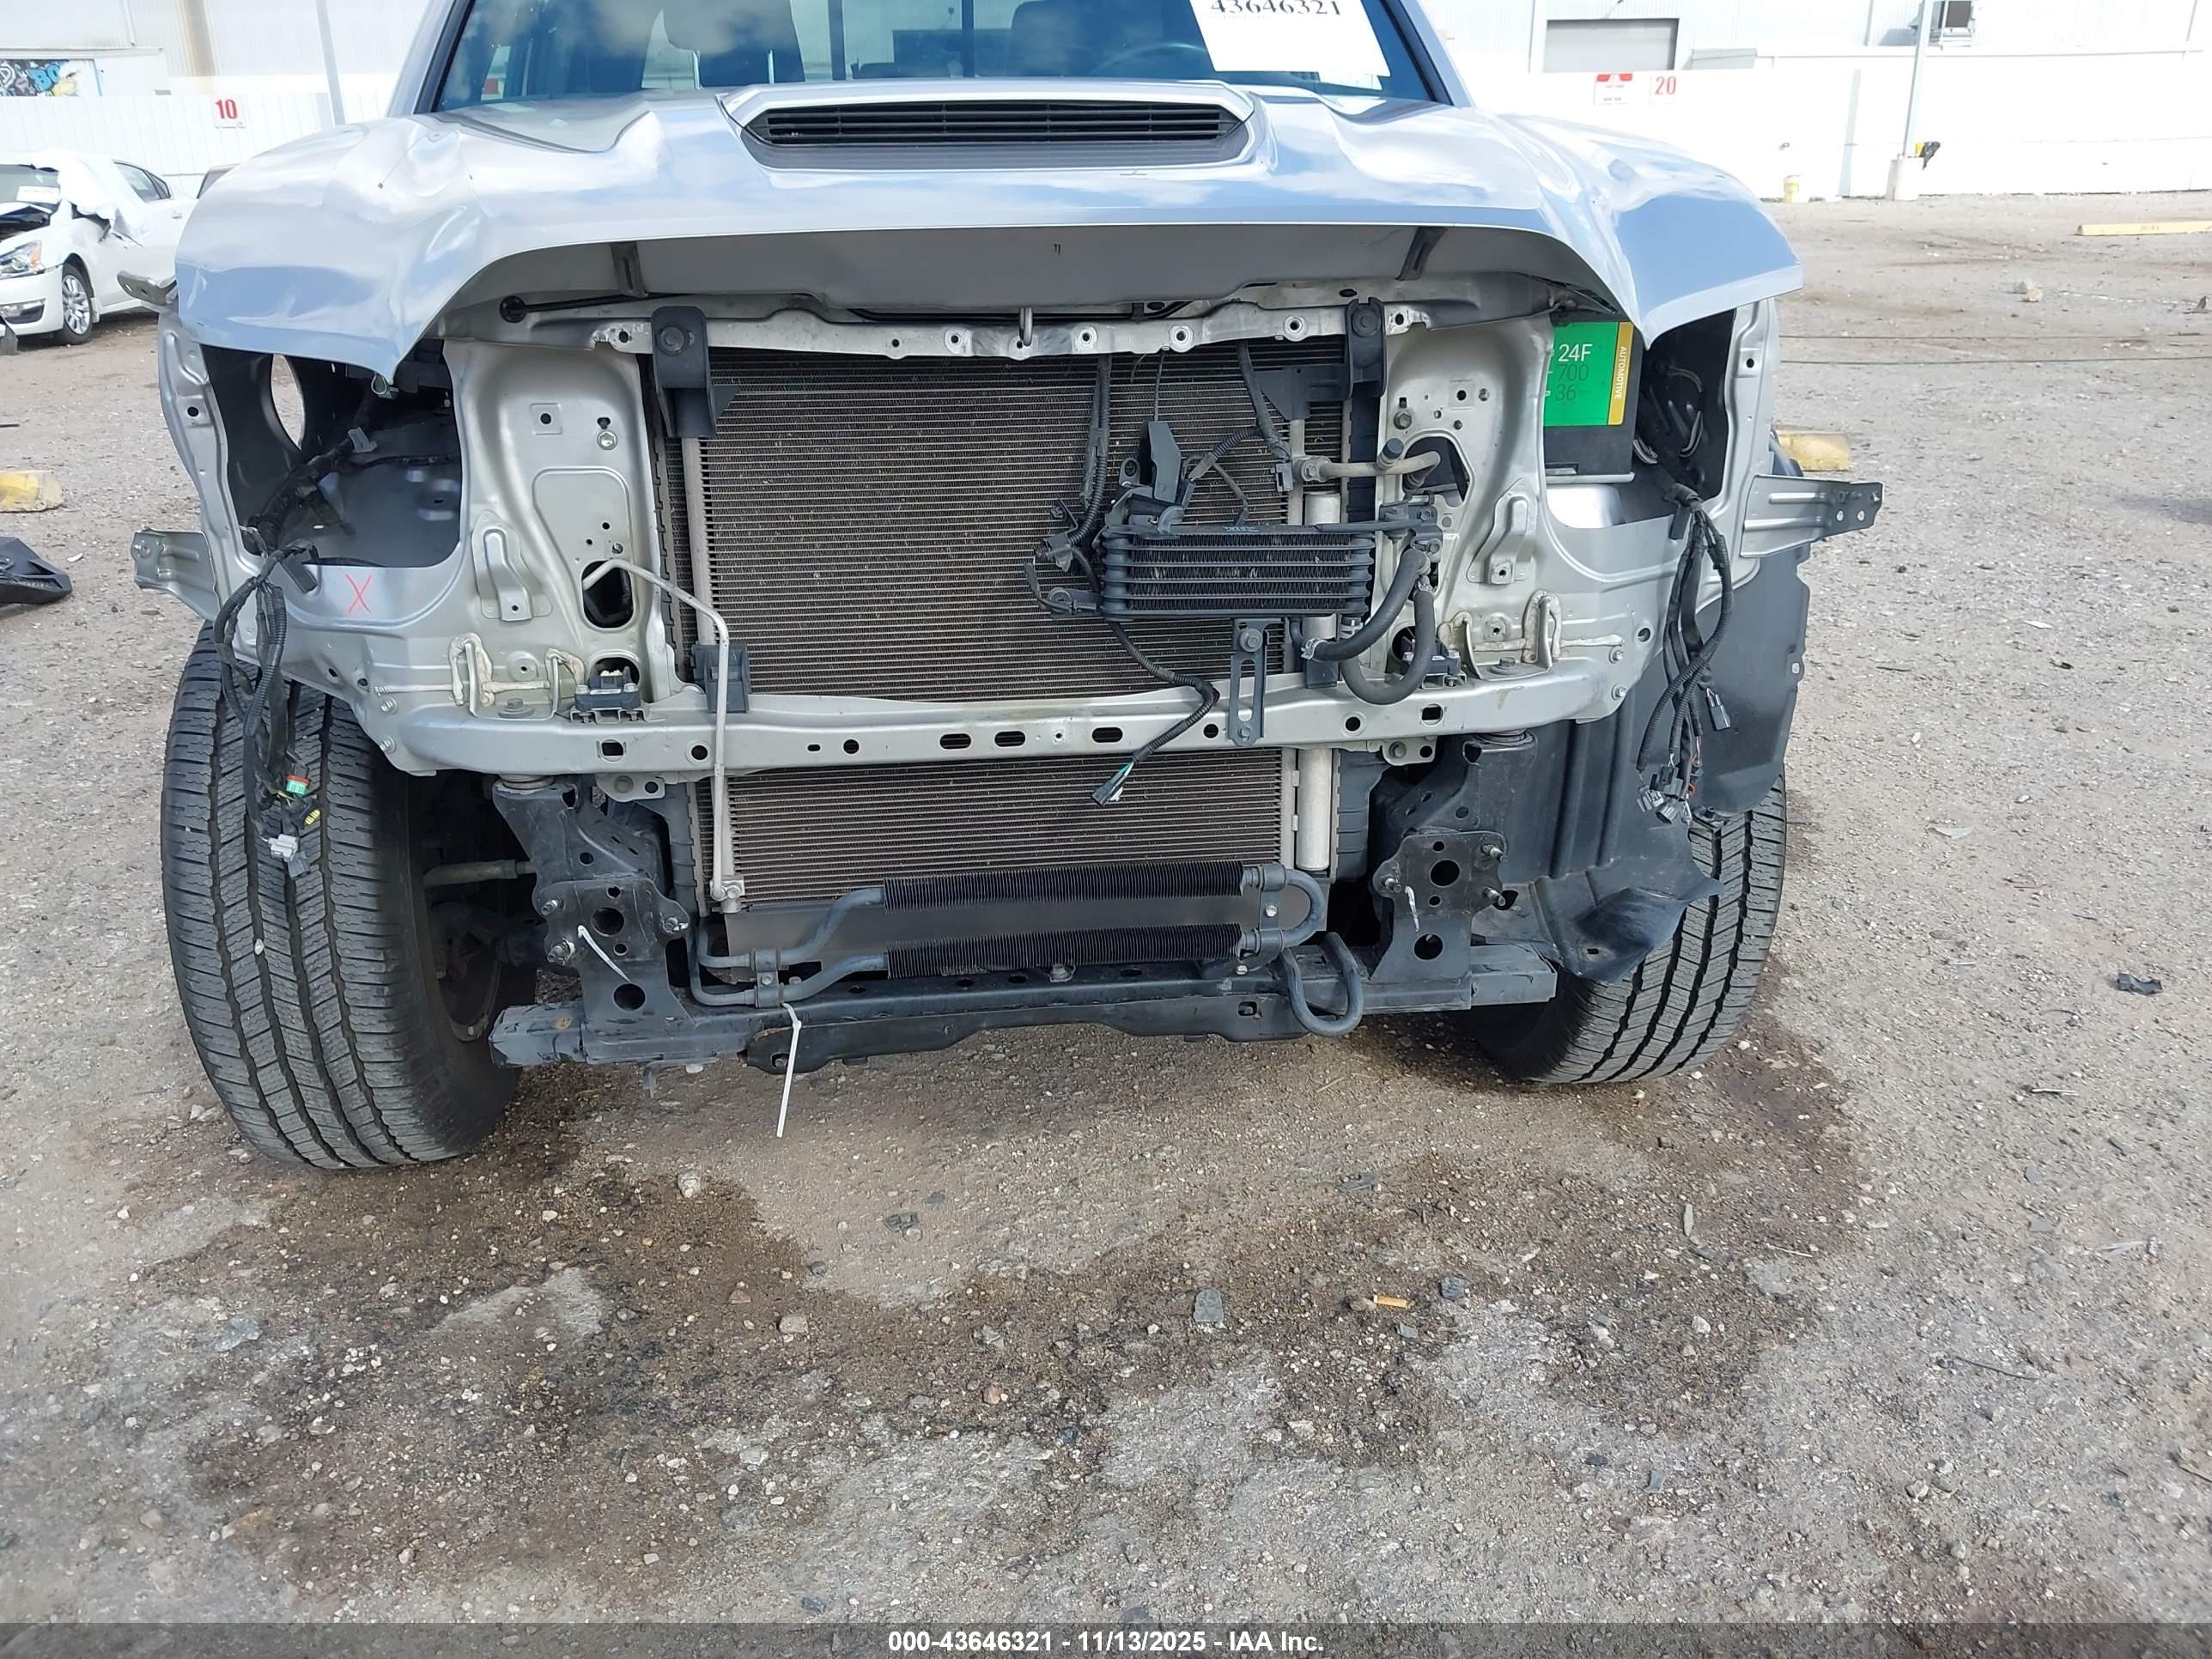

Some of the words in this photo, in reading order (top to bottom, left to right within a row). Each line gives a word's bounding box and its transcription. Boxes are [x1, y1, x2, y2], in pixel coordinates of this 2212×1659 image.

[1211, 0, 1341, 15] 43646321
[1655, 76, 1677, 95] 20
[215, 99, 237, 119] 10
[1558, 343, 1593, 362] 24F
[1558, 363, 1589, 381] 700
[1614, 346, 1627, 399] AUTOMOTIVE
[1555, 384, 1577, 401] 36
